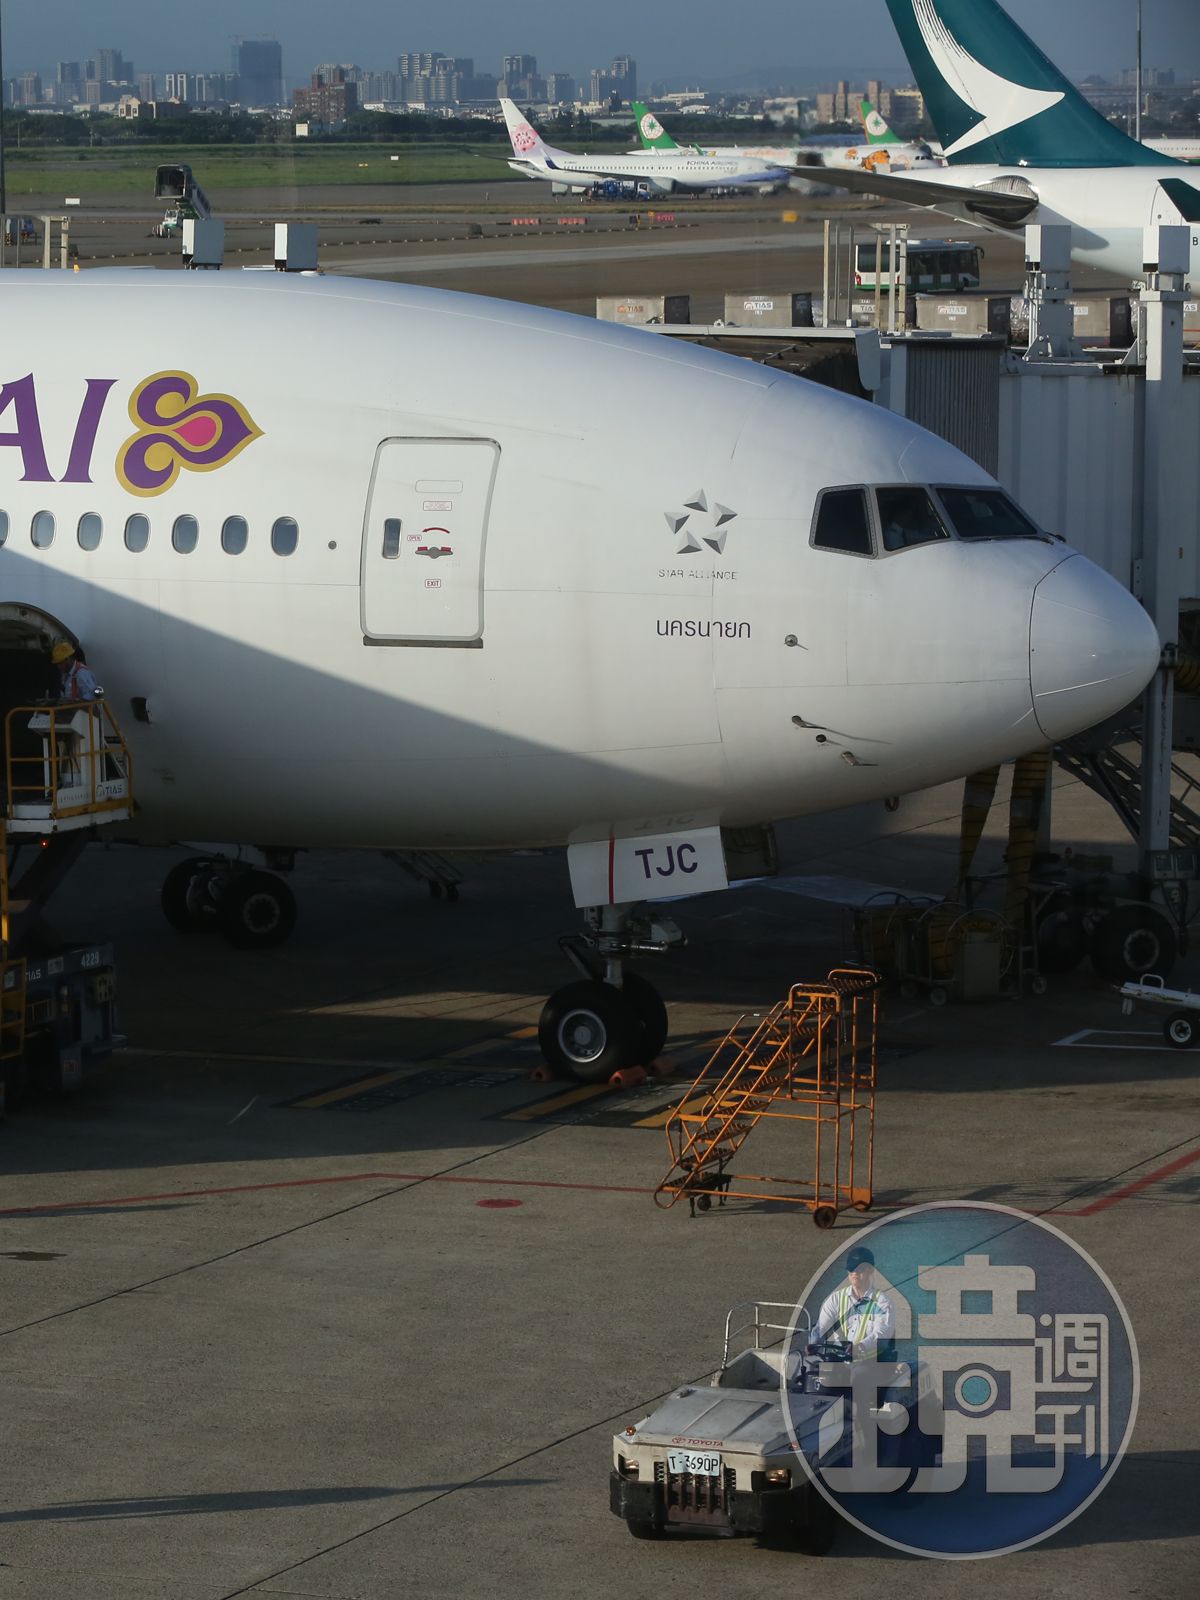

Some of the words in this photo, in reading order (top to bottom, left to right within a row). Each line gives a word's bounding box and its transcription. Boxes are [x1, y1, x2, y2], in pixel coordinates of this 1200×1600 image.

[658, 569, 684, 578] STAR
[656, 619, 752, 639] นครนายก
[635, 843, 699, 879] TJC
[81, 951, 100, 968] 4229
[687, 1438, 724, 1447] TOYOTA
[669, 1455, 719, 1473] T-3690P
